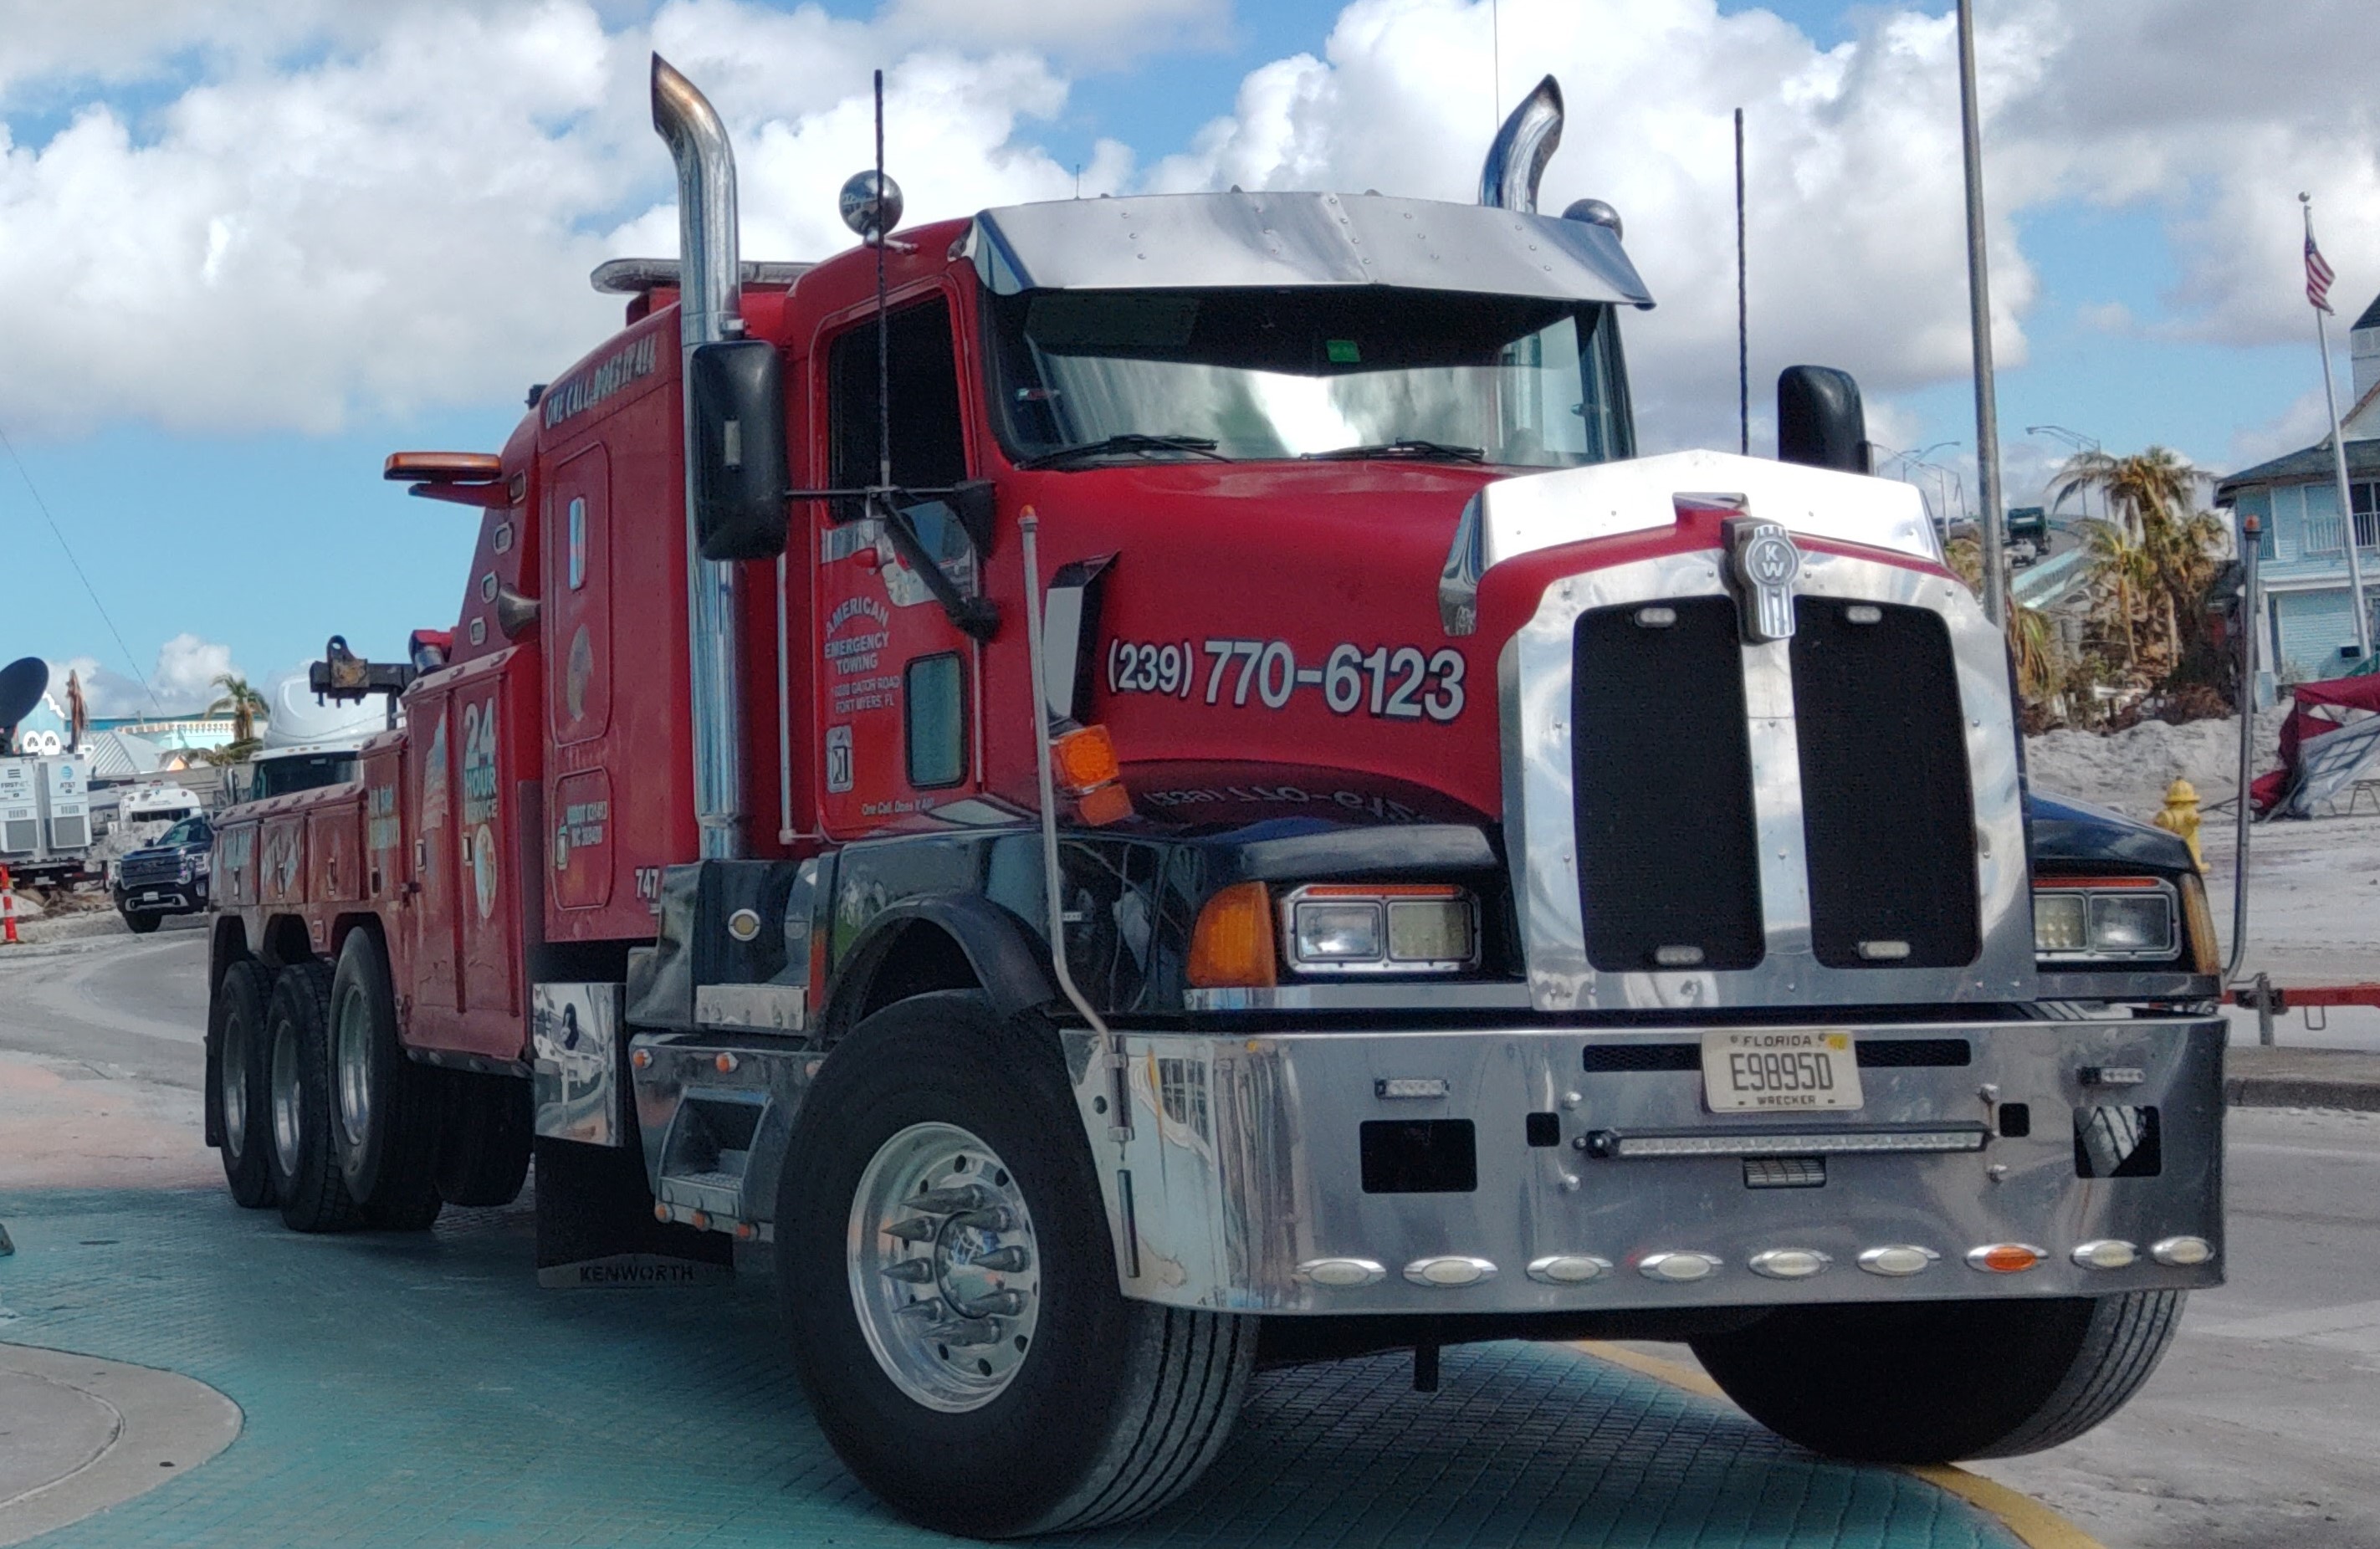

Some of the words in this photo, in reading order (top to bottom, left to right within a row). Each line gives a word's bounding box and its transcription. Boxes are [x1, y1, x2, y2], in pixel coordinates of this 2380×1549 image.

[826, 596, 889, 639] AMERICAN
[824, 631, 889, 658] EMERGENCY
[836, 652, 878, 675] TOWING
[1108, 638, 1193, 698] (239)
[1205, 641, 1465, 721] 770-6123
[836, 699, 854, 714] FORT
[464, 697, 496, 769] 24
[465, 766, 497, 800] HOUR
[465, 798, 499, 825] SERVICE
[635, 868, 660, 899] 747
[1743, 1035, 1812, 1046] FLORIDA
[1757, 1095, 1816, 1105] WRECKER
[580, 1265, 694, 1282] KENWORTH
